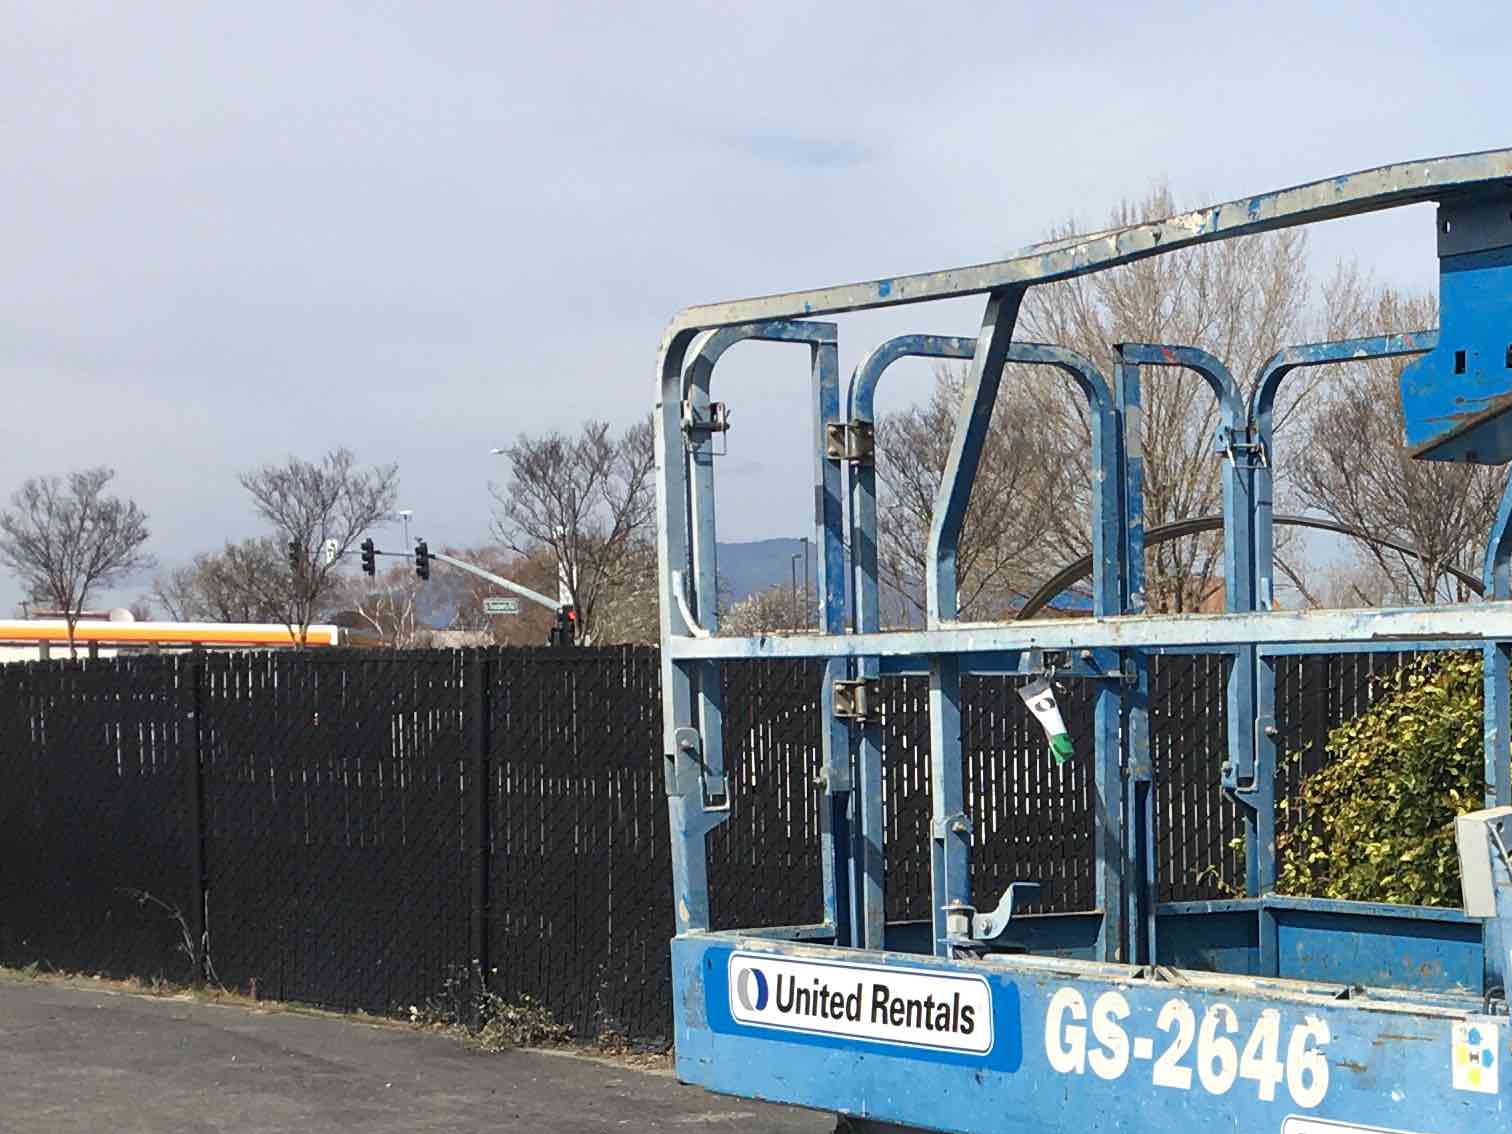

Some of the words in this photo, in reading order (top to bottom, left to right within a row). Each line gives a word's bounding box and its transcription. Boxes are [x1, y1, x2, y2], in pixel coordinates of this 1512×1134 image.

[776, 973, 863, 1023] United
[870, 983, 976, 1035] Rentals
[1045, 986, 1330, 1108] GS-2646
